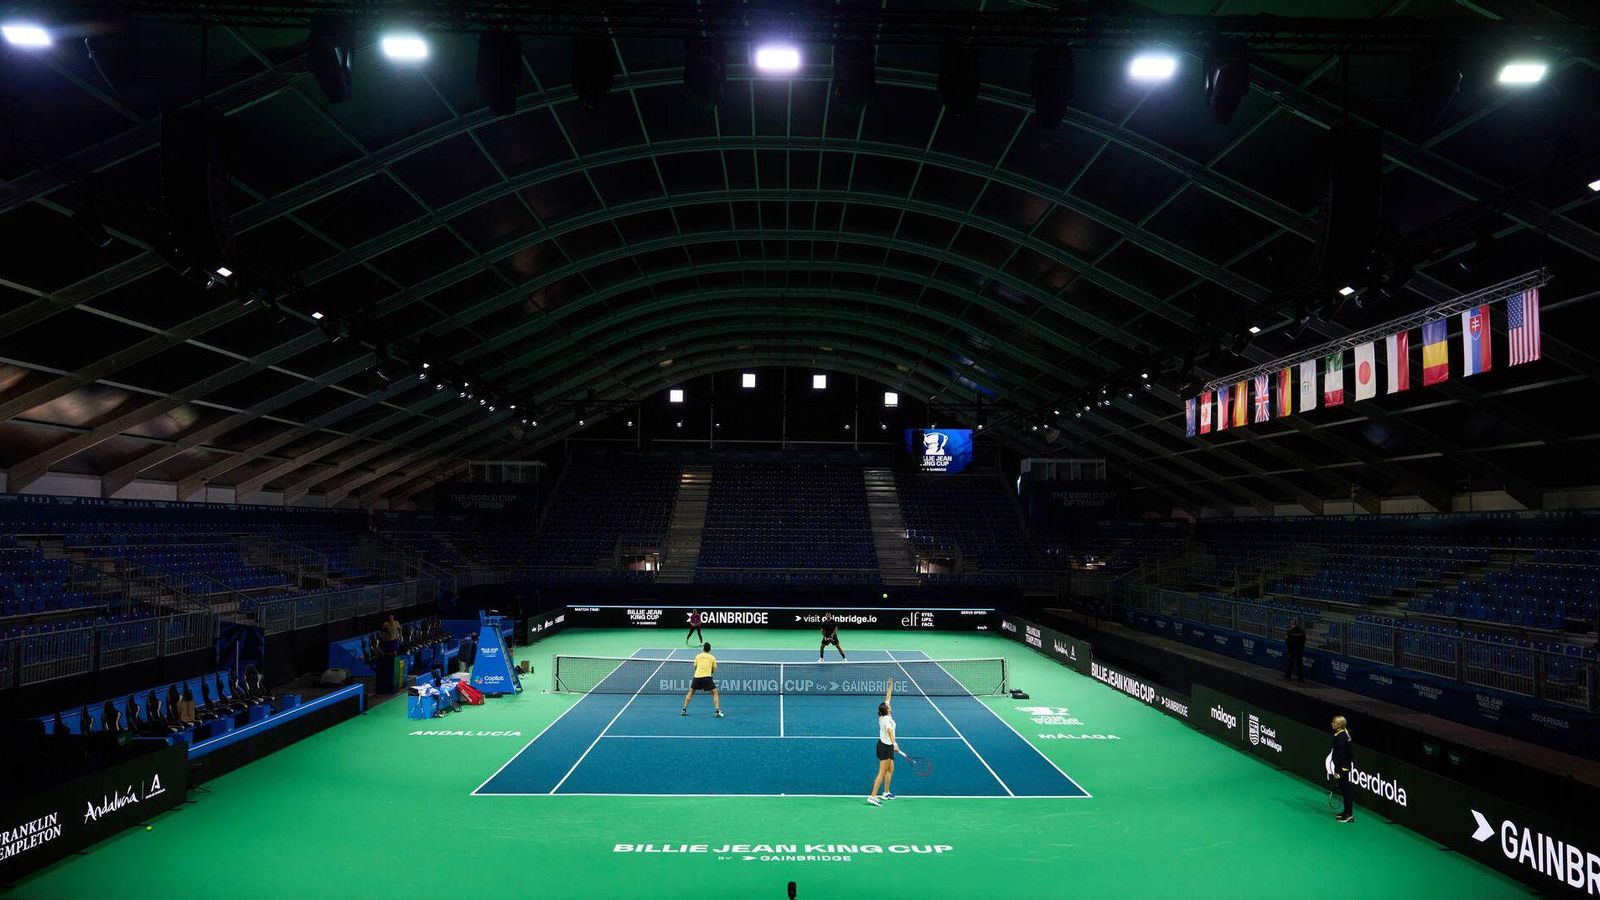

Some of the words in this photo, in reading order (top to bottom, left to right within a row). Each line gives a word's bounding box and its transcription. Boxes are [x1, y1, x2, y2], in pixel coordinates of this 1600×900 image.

[700, 612, 768, 624] GAINBRIDGE
[822, 615, 877, 624] ginbridge.io
[901, 612, 919, 626] elf
[660, 680, 691, 692] BILL
[716, 680, 740, 692] EAN
[742, 680, 779, 692] KING
[785, 680, 814, 692] CUP
[816, 682, 828, 692] by
[1092, 662, 1107, 682] BILLIE
[1107, 670, 1123, 690] JEAN
[1124, 676, 1140, 698] KING
[1140, 684, 1155, 703] CUP
[1211, 704, 1236, 729] málaga
[1260, 724, 1276, 738] Ciudad
[1260, 736, 1266, 744] de
[84, 784, 139, 824] Andalucía
[0, 812, 58, 846] RANKLIN
[0, 824, 62, 860] EMPLETON
[613, 844, 709, 853] BILLIE
[712, 844, 797, 853] JEAN
[804, 844, 883, 854] KING
[888, 845, 953, 854] CUP
